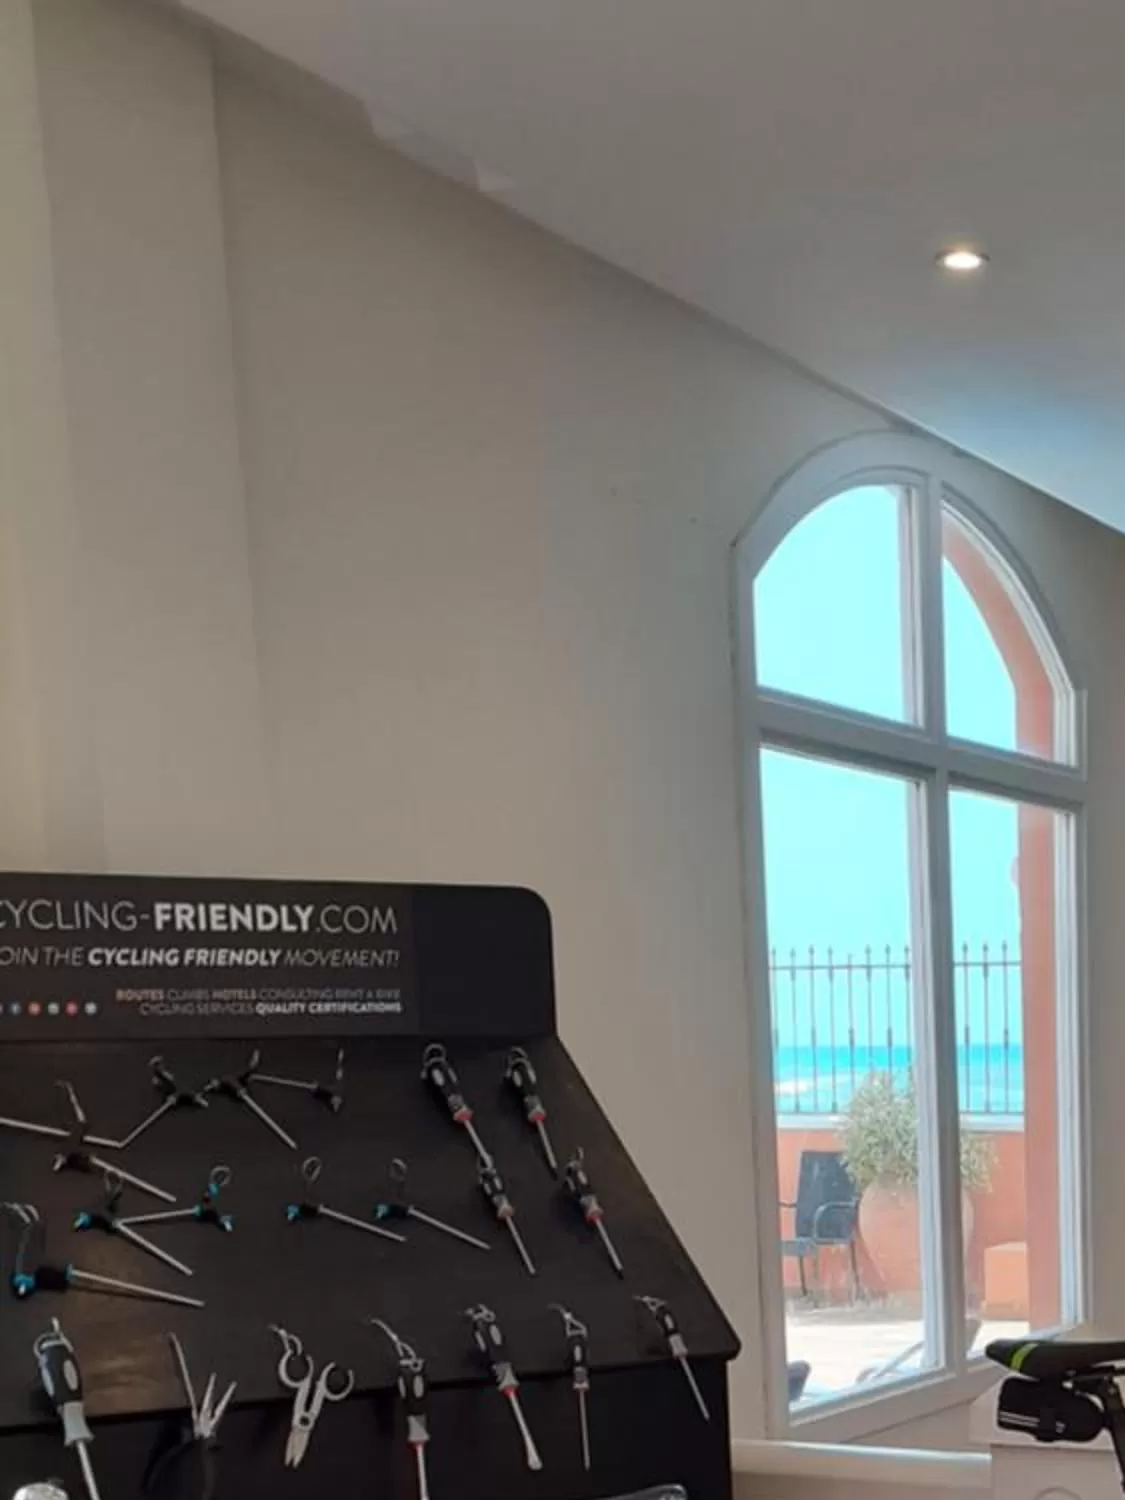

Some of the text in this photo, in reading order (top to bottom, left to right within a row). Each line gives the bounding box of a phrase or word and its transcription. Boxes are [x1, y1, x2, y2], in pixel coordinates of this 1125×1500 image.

[0, 898, 398, 934] YCLING-FRIENDLY.COM
[0, 946, 39, 966] OIN
[42, 946, 85, 966] THE
[88, 947, 180, 967] CYCLING
[183, 948, 282, 967] FRIENDLY
[256, 1001, 306, 1016] QUALITY
[308, 1001, 402, 1015] CERTIFICATIONS
